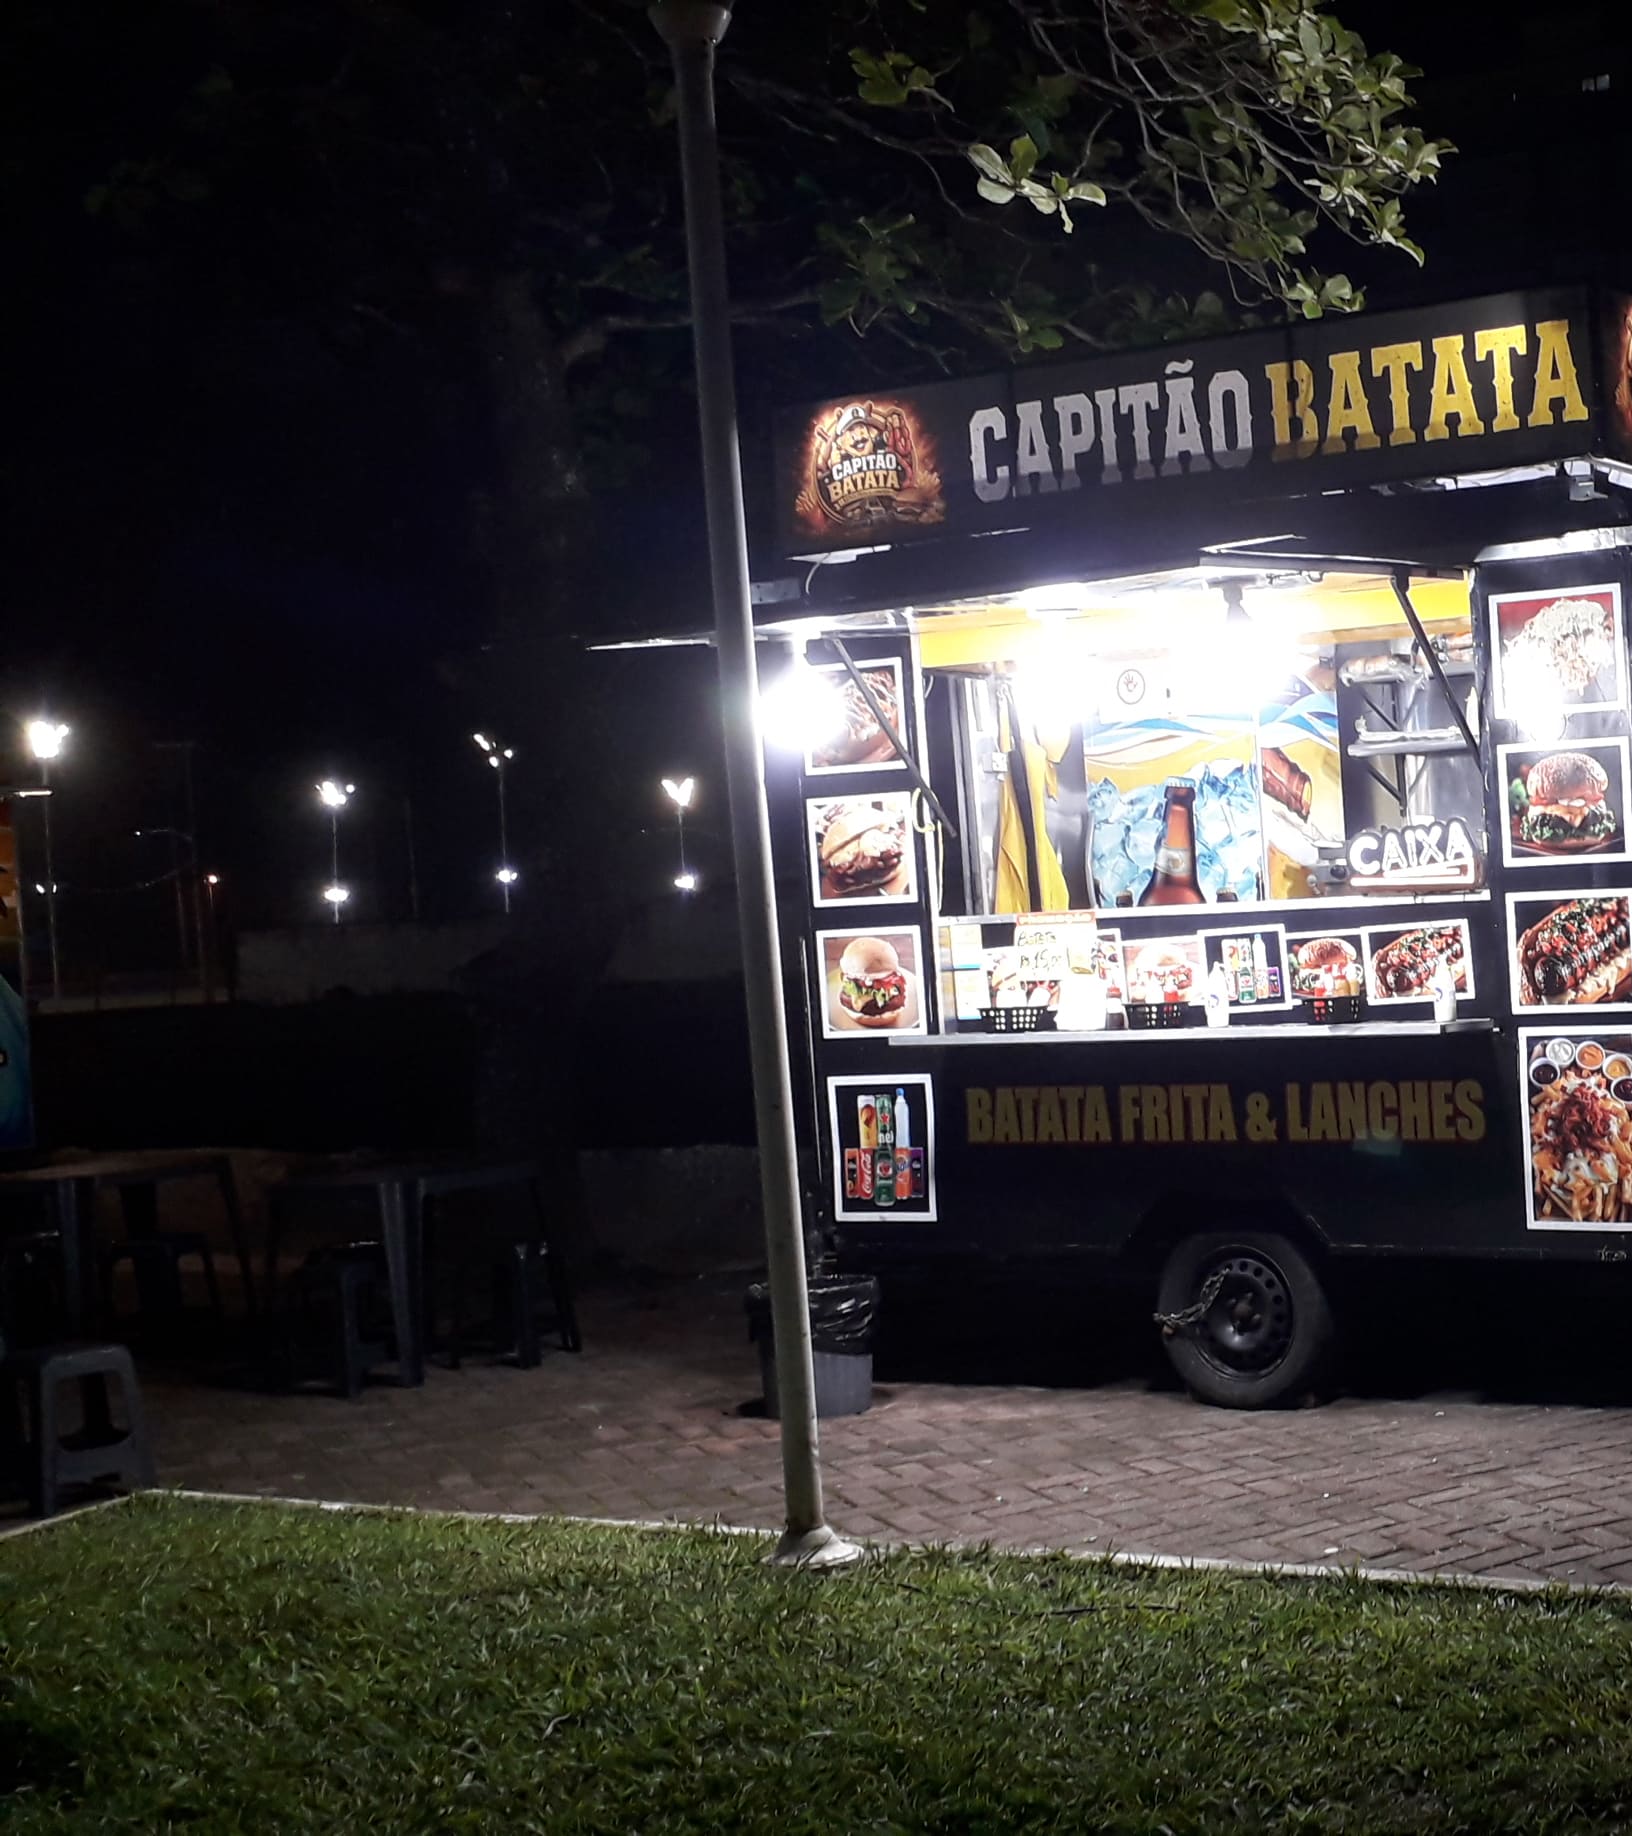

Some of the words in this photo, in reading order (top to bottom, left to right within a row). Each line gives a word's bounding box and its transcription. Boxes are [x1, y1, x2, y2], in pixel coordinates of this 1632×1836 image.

[968, 358, 1253, 502] CAPITÃO
[1265, 320, 1589, 462] BATATA
[827, 471, 901, 503] BATATA
[832, 450, 897, 481] CAPITÃO
[1350, 821, 1474, 875] CAIXA
[965, 1085, 1113, 1143] BATATA
[1119, 1083, 1237, 1143] FRITA
[1245, 1091, 1279, 1141] &
[1285, 1078, 1487, 1142] LANCHES
